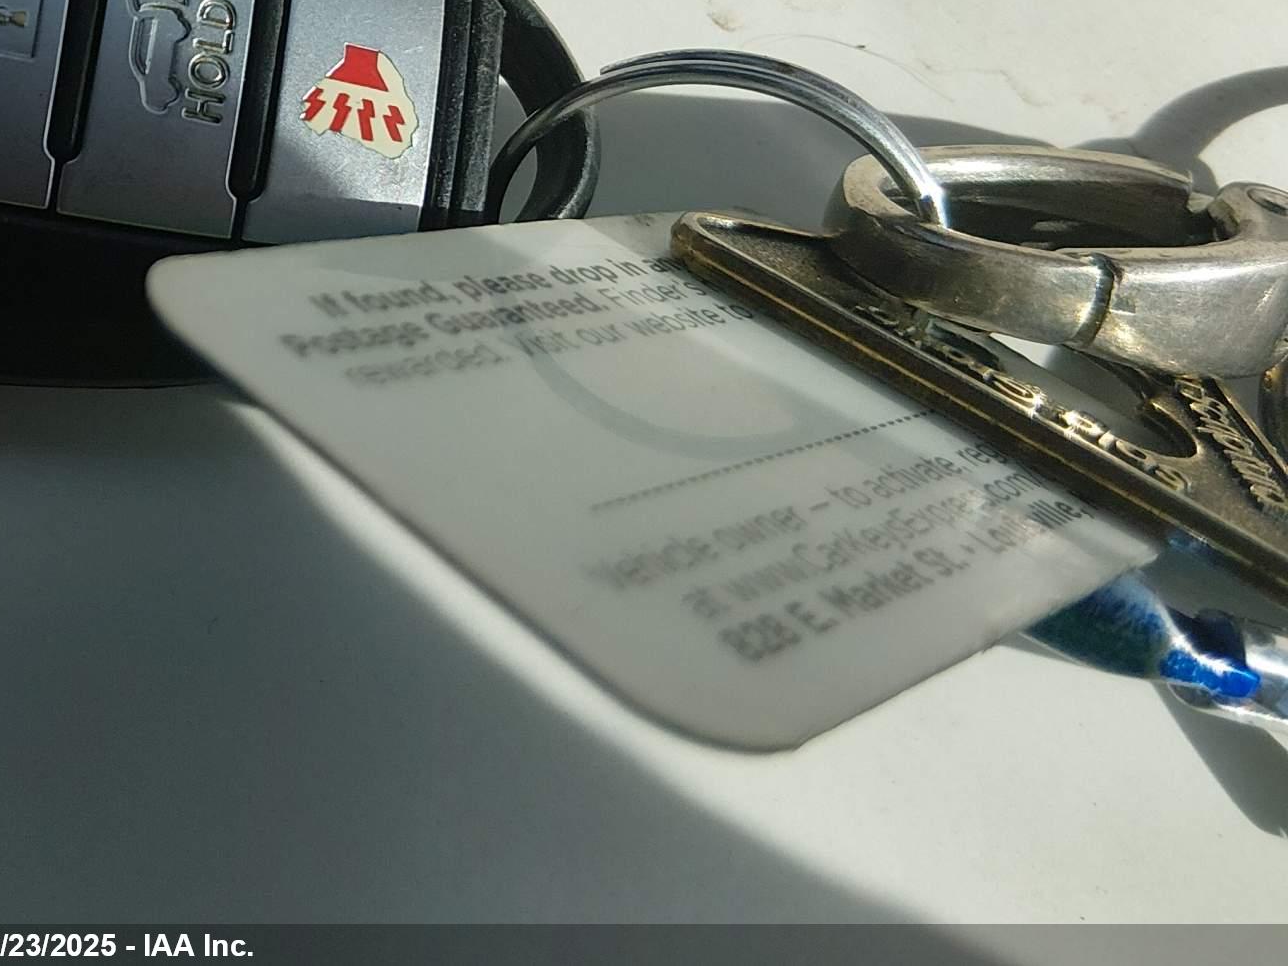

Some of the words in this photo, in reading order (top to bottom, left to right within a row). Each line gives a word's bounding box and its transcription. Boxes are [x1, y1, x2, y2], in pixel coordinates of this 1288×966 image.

[341, 280, 462, 314] found,
[454, 272, 553, 302] please
[550, 263, 618, 284] drop
[605, 257, 648, 277] in
[424, 291, 610, 335] Guaranteed.
[598, 279, 707, 308] Finder's
[514, 328, 581, 357] Visit
[576, 322, 629, 346] our
[624, 305, 726, 336] website
[717, 301, 754, 320] to
[824, 486, 872, 509] to
[872, 454, 972, 499] activate,
[817, 560, 935, 617] Market
[913, 544, 970, 577] St.
